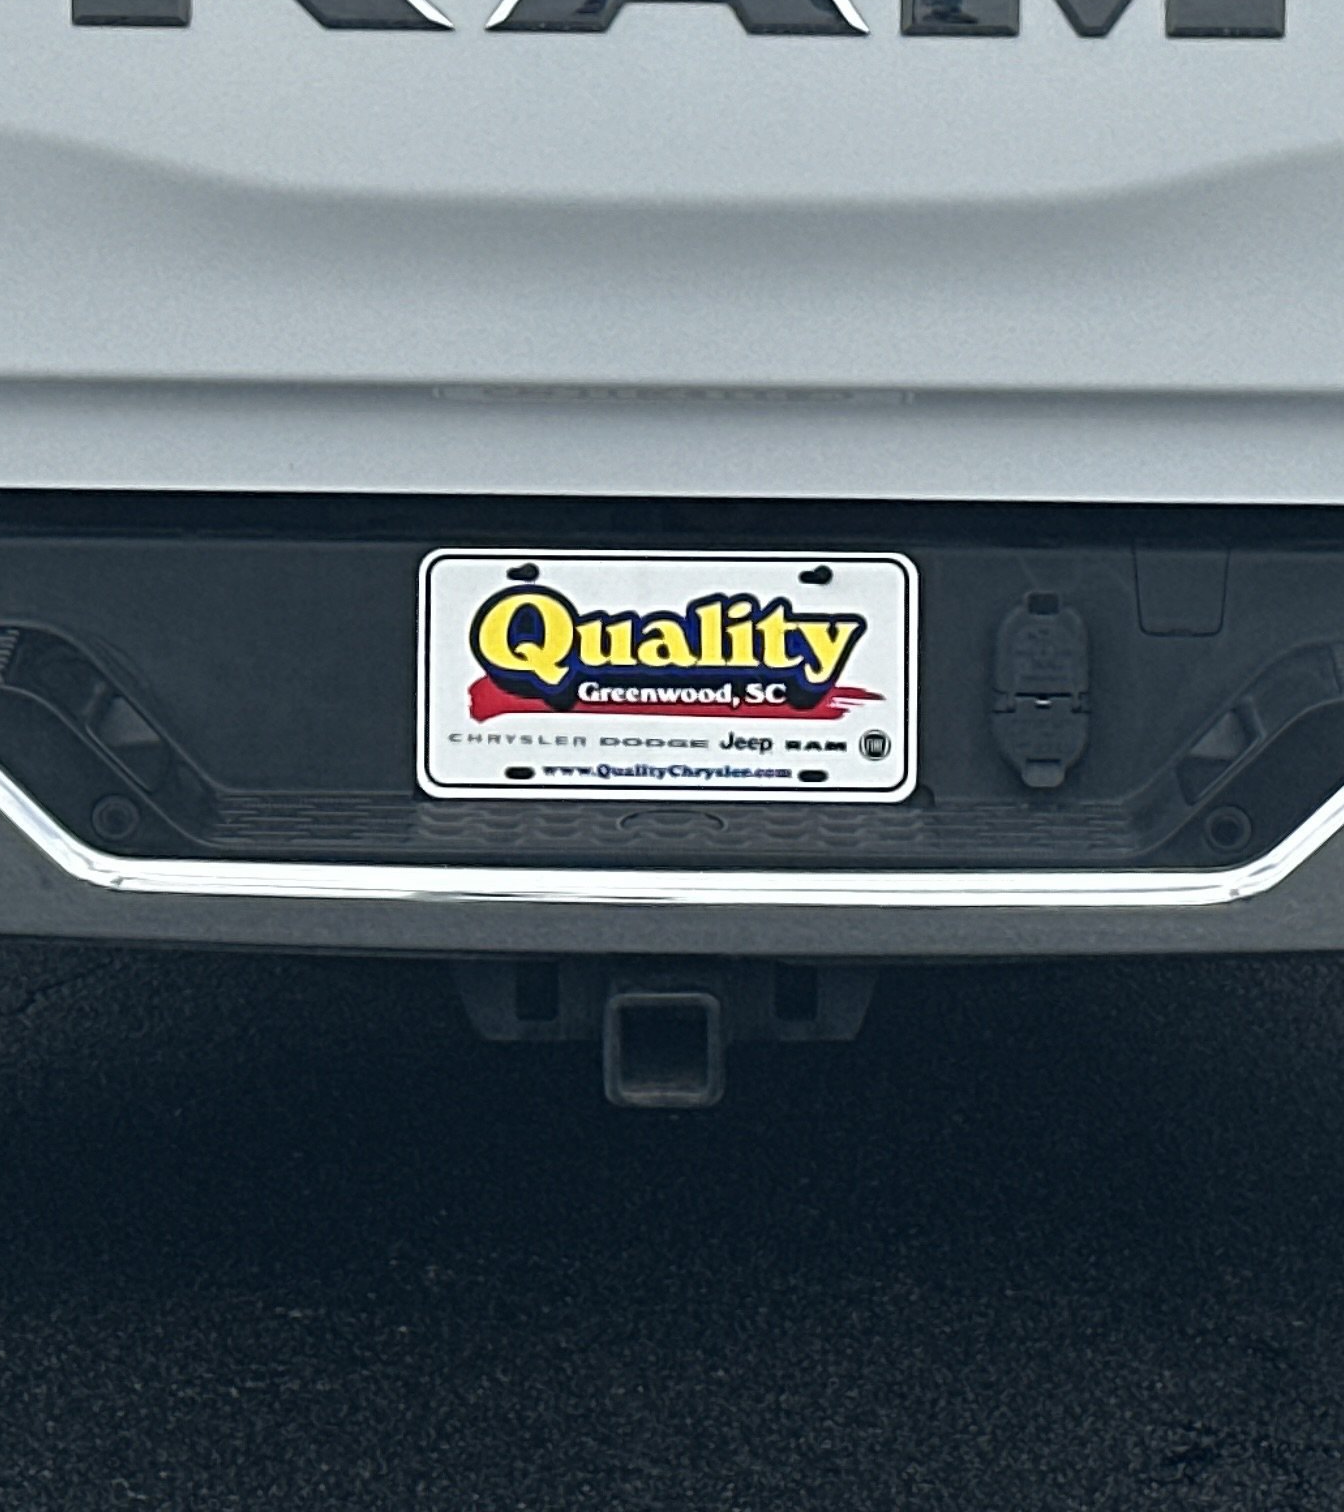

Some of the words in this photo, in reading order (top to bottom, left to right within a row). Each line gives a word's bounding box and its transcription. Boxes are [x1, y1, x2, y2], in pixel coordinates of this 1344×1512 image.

[474, 590, 862, 686] Quality
[577, 682, 741, 708] Greenwood,
[744, 683, 787, 705] SC
[447, 732, 587, 748] CHRYSLER
[599, 736, 709, 750] DODGE
[720, 731, 774, 754] Jeep
[785, 740, 848, 752] RAM
[542, 763, 793, 780] www.QualityChrysler.com
